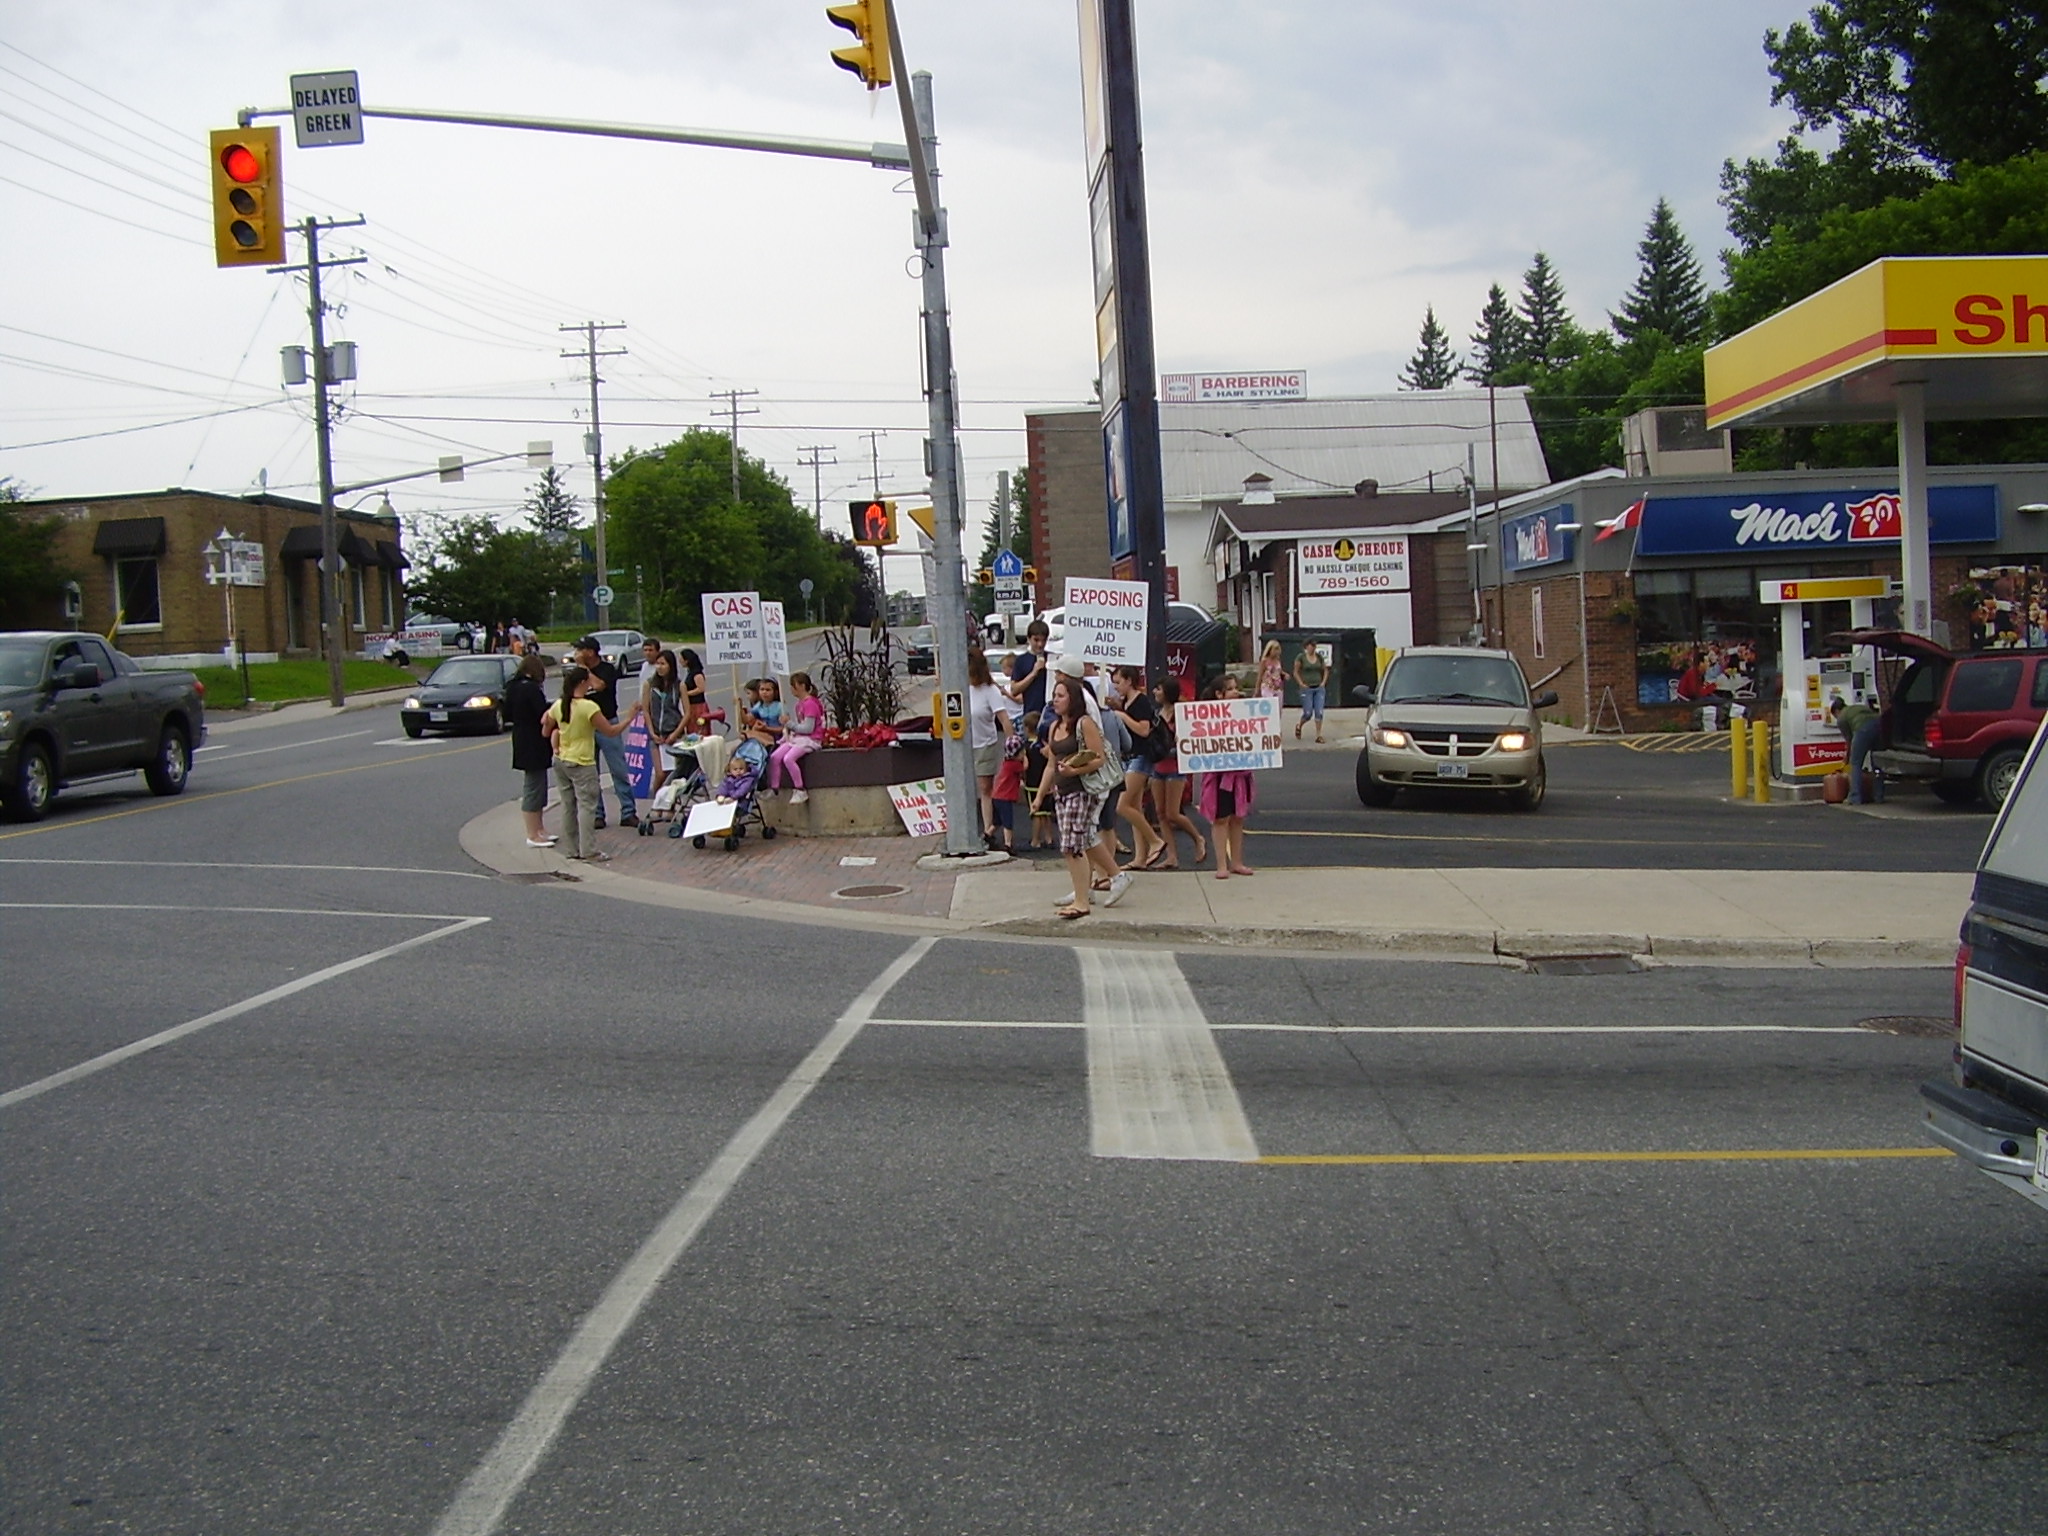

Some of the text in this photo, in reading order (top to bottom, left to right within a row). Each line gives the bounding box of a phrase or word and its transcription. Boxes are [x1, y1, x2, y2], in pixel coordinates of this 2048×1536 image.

[295, 87, 357, 107] DELAYED
[305, 113, 351, 133] GREEN
[1201, 375, 1299, 390] BARBERING
[1202, 387, 1300, 398] & HAIR STYLING
[1730, 502, 1842, 545] Mac's
[1303, 544, 1333, 559] CASH
[1357, 541, 1404, 557] CHEQUE
[1304, 561, 1403, 574] NO HASSLE CHEQUE CASHING
[1319, 575, 1389, 588] 789-1560
[996, 591, 1021, 599] km/h
[1070, 588, 1143, 608] EXPOSING
[1783, 585, 1794, 598] 4
[711, 596, 753, 616] CAS
[764, 607, 781, 625] CAS
[1069, 616, 1142, 631] CHILDREN'S
[715, 620, 751, 629] WILL NOT
[710, 630, 757, 640] LET ME SEE
[1095, 631, 1115, 643] AID
[719, 651, 752, 660] FRIENDS
[1083, 645, 1126, 657] ABUSE
[1184, 700, 1271, 720] HONK TO
[1190, 717, 1269, 737] SUPPORT
[1180, 734, 1281, 754] CHILDRENS AID
